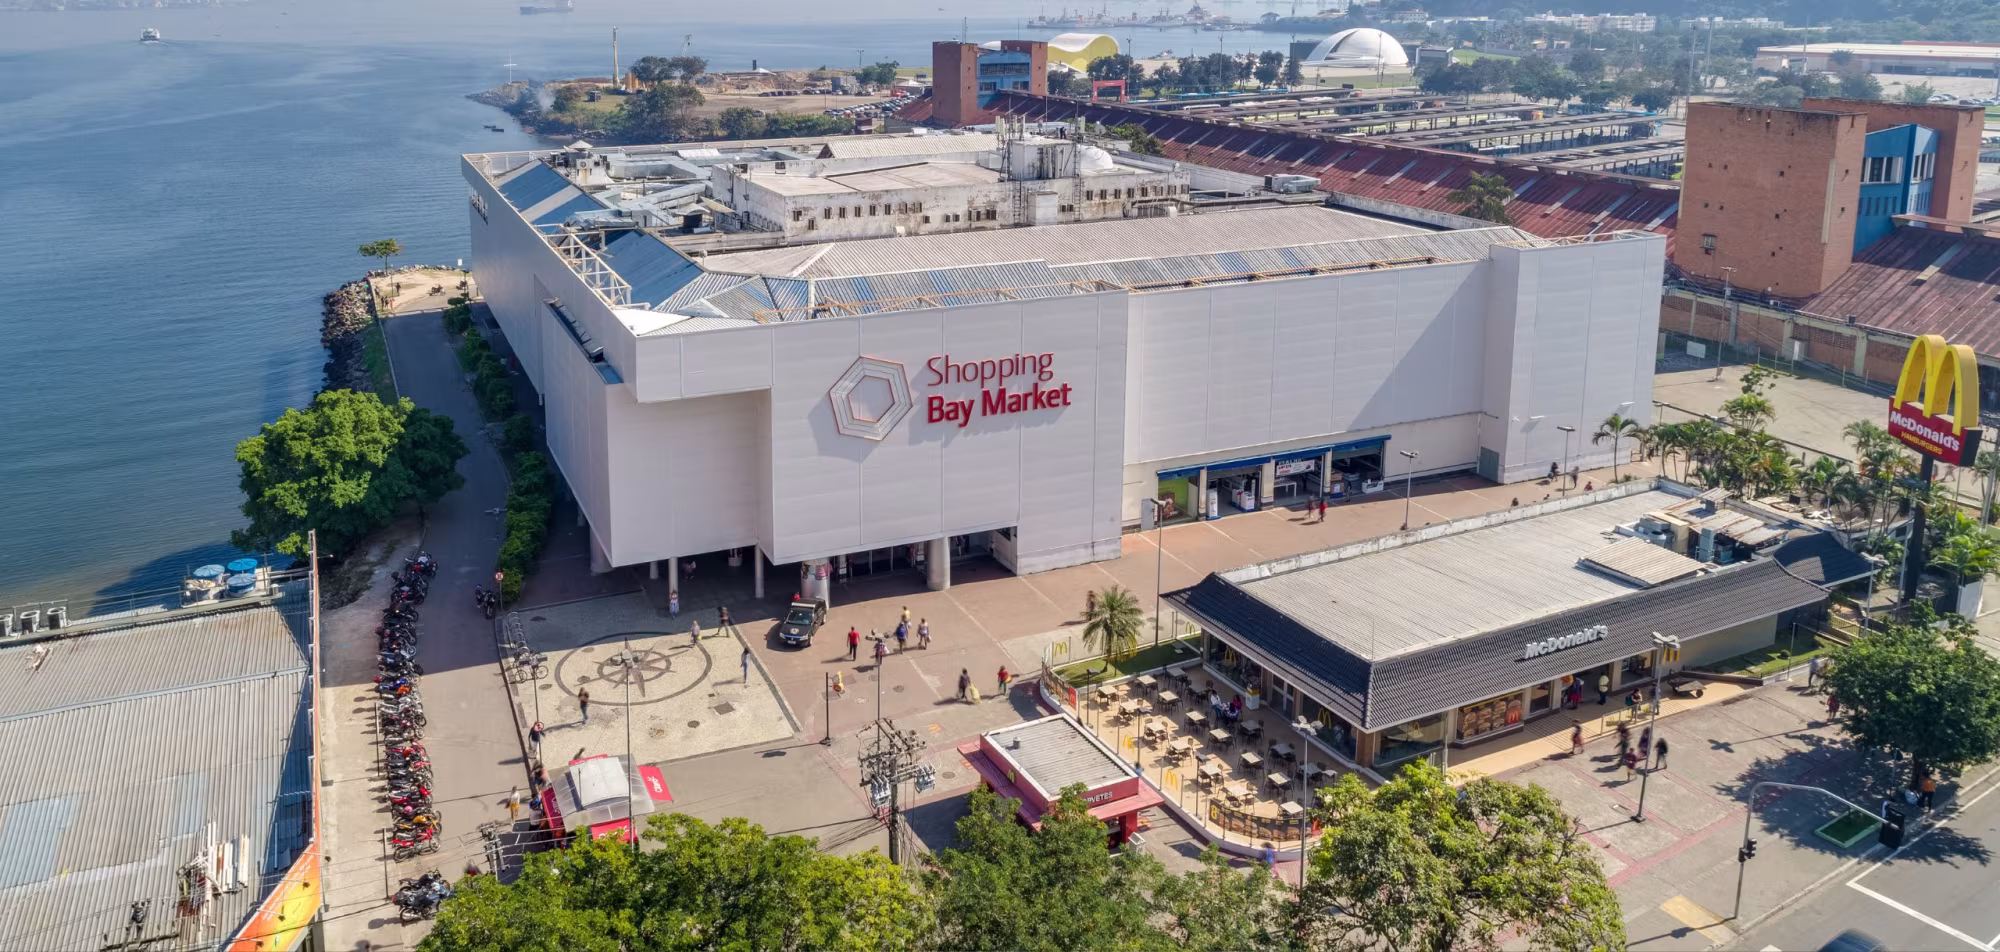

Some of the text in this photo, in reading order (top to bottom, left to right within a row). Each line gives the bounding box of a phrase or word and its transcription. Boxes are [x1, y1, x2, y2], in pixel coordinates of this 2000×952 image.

[926, 352, 1055, 388] Shopping
[927, 382, 1073, 428] Bay Market
[1890, 410, 1960, 452] McDonald's
[1901, 431, 1943, 455] HAMBURGERS
[1524, 624, 1609, 659] McDonald's
[1080, 791, 1113, 804] RVETES
